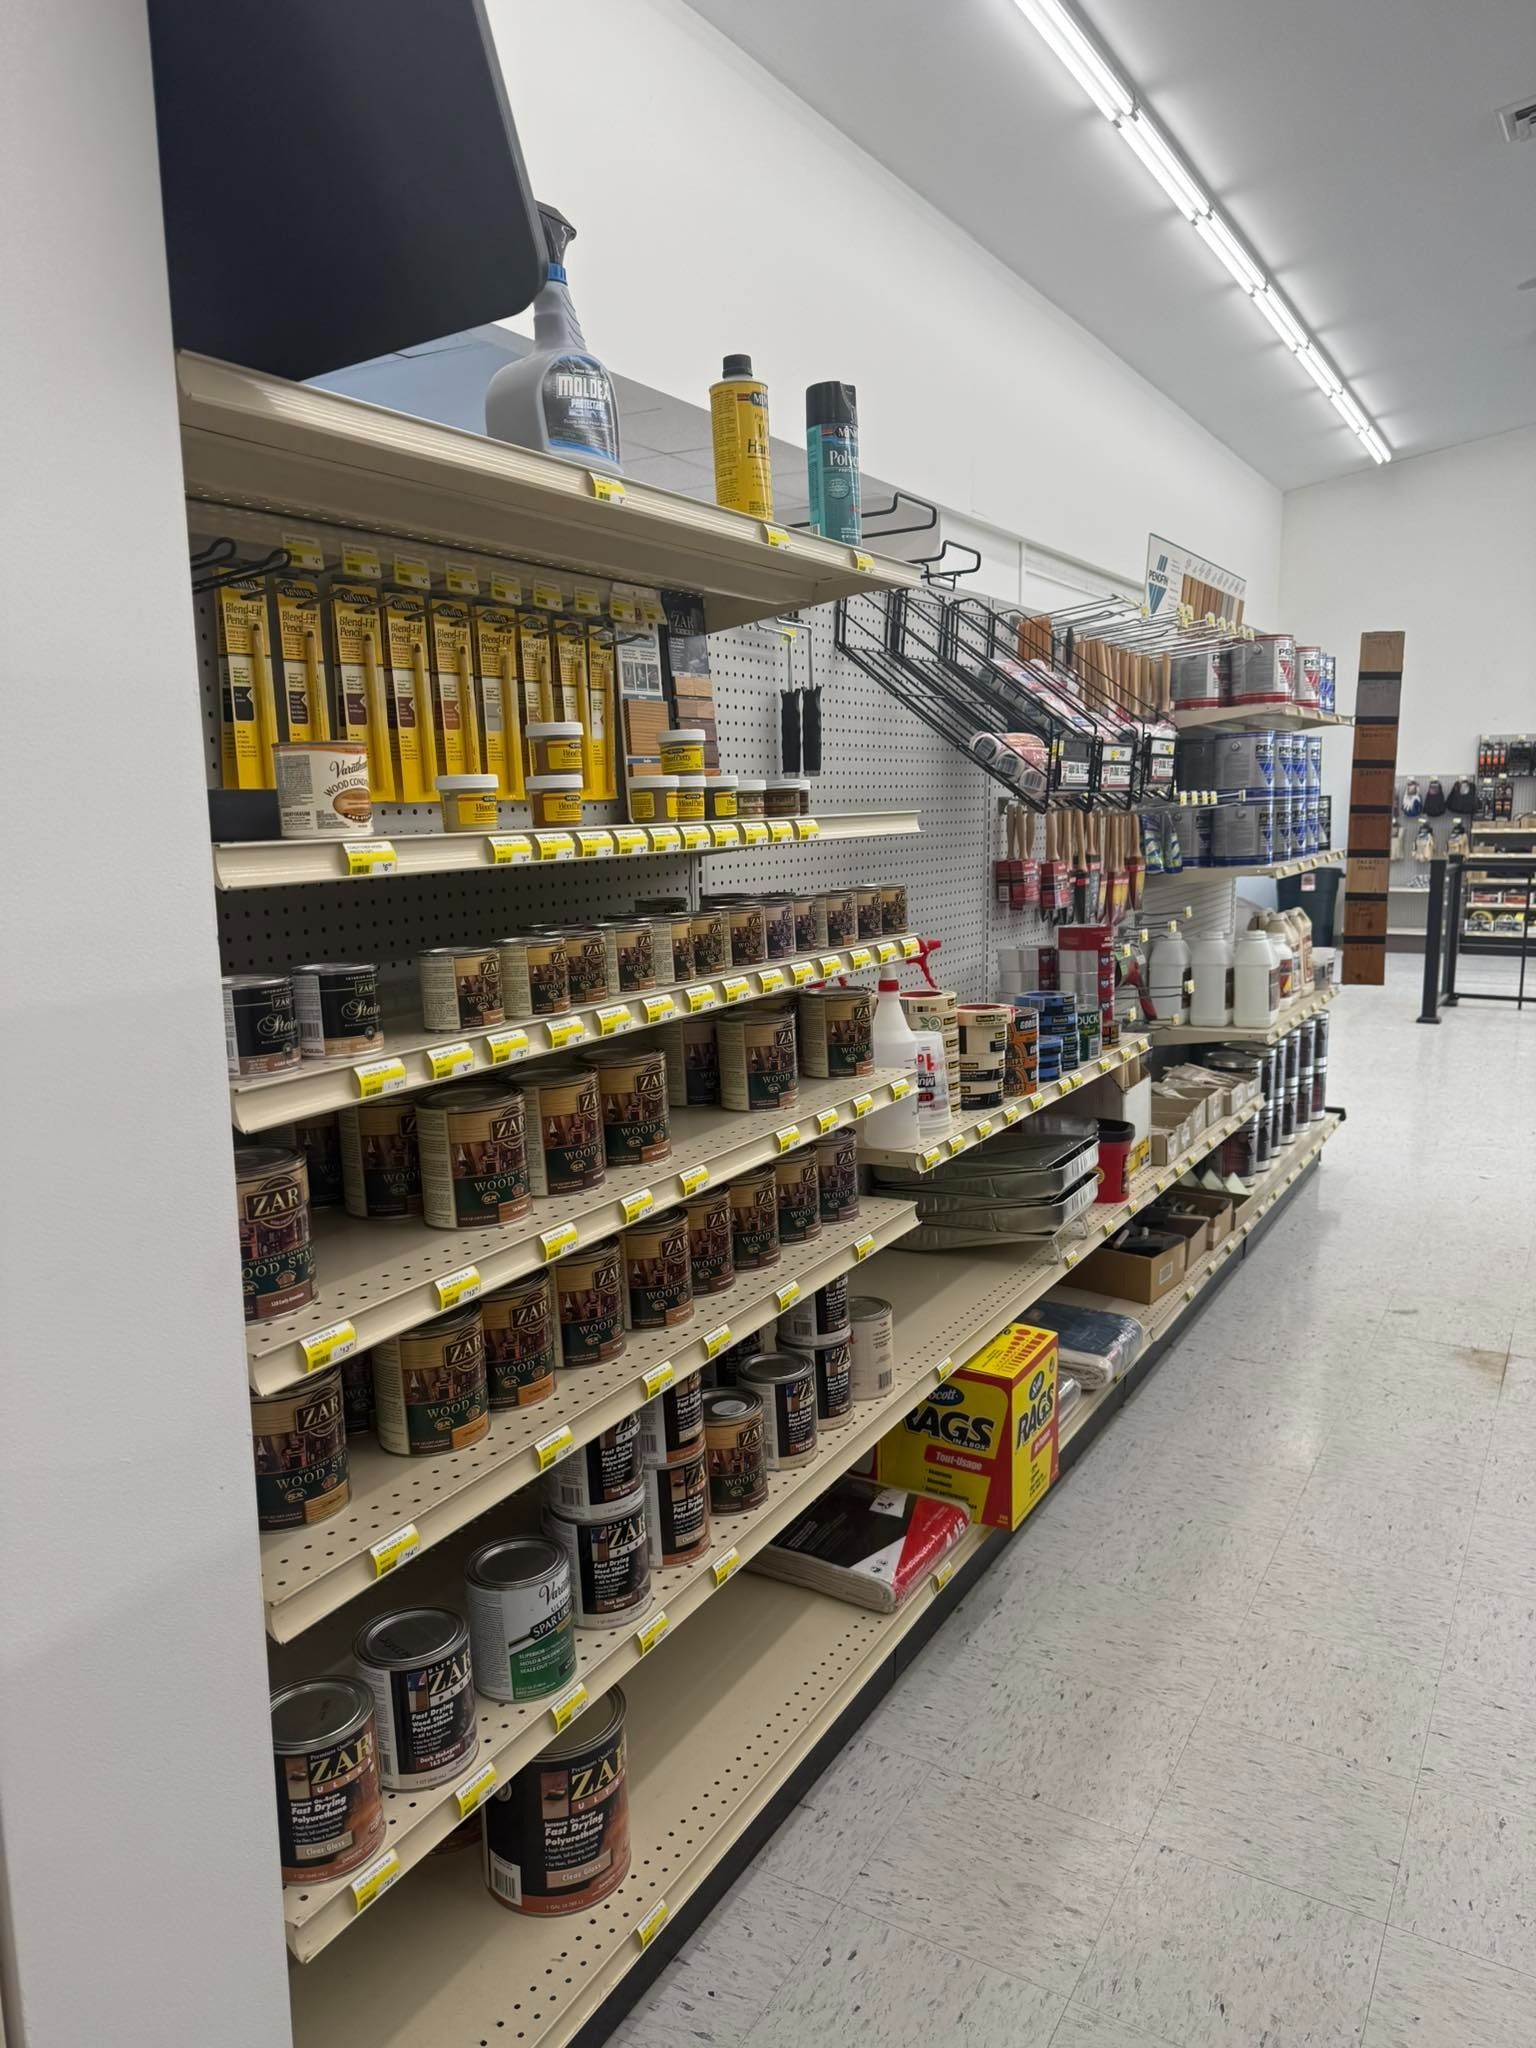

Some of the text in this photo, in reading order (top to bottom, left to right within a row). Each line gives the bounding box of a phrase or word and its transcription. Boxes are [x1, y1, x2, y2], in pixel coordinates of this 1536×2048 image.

[557, 374, 611, 402] MOLDEX
[1148, 569, 1169, 587] PENOFIN
[339, 616, 376, 629] Blend-Fil
[323, 778, 349, 798] WOOD
[358, 985, 374, 995] ZAR
[467, 993, 494, 1004] WOOD
[274, 997, 291, 1009] ZAR
[1077, 1014, 1099, 1026] DUCK
[841, 1044, 867, 1054] WOOD
[762, 1073, 791, 1084] WOOD
[620, 1123, 656, 1137] WOOD
[564, 1145, 596, 1161] WOOD
[474, 1176, 515, 1193] WOOD
[253, 1186, 300, 1217] ZAR
[823, 1190, 850, 1200] WOOD
[790, 1207, 816, 1219] WOOD
[742, 1231, 771, 1245] WOOD
[242, 1262, 280, 1280] OOD
[692, 1256, 724, 1269] WOOD
[646, 1286, 680, 1301] WOOD
[517, 1300, 547, 1327] ZAR
[578, 1317, 614, 1336] WOOD
[450, 1335, 482, 1364] ZAR
[494, 1358, 535, 1377] WOOD
[302, 1396, 339, 1429] ZAR
[427, 1399, 470, 1419] WOOD
[1016, 1382, 1054, 1451] RAGS
[601, 1447, 615, 1457] Fast
[952, 1437, 985, 1451] IN A BOX
[936, 1450, 983, 1471] Tout-Usage
[276, 1467, 325, 1490] WOOD
[724, 1472, 756, 1488] WOOD
[673, 1505, 687, 1514] Fast
[609, 1556, 630, 1567] Drying
[533, 1616, 557, 1639] SPAR
[411, 1701, 454, 1721] Fast Drying
[412, 1718, 431, 1728] Wood
[412, 1716, 454, 1734] Polyurethane
[310, 1732, 372, 1785] ZAR
[291, 1795, 347, 1816] Fast Drying
[292, 1804, 347, 1824] Polyurethane
[545, 1812, 604, 1836] Fast Drying
[545, 1823, 604, 1847] Polyurethane
[306, 1840, 346, 1857] Clear Gloss
[562, 1872, 582, 1882] Clear
